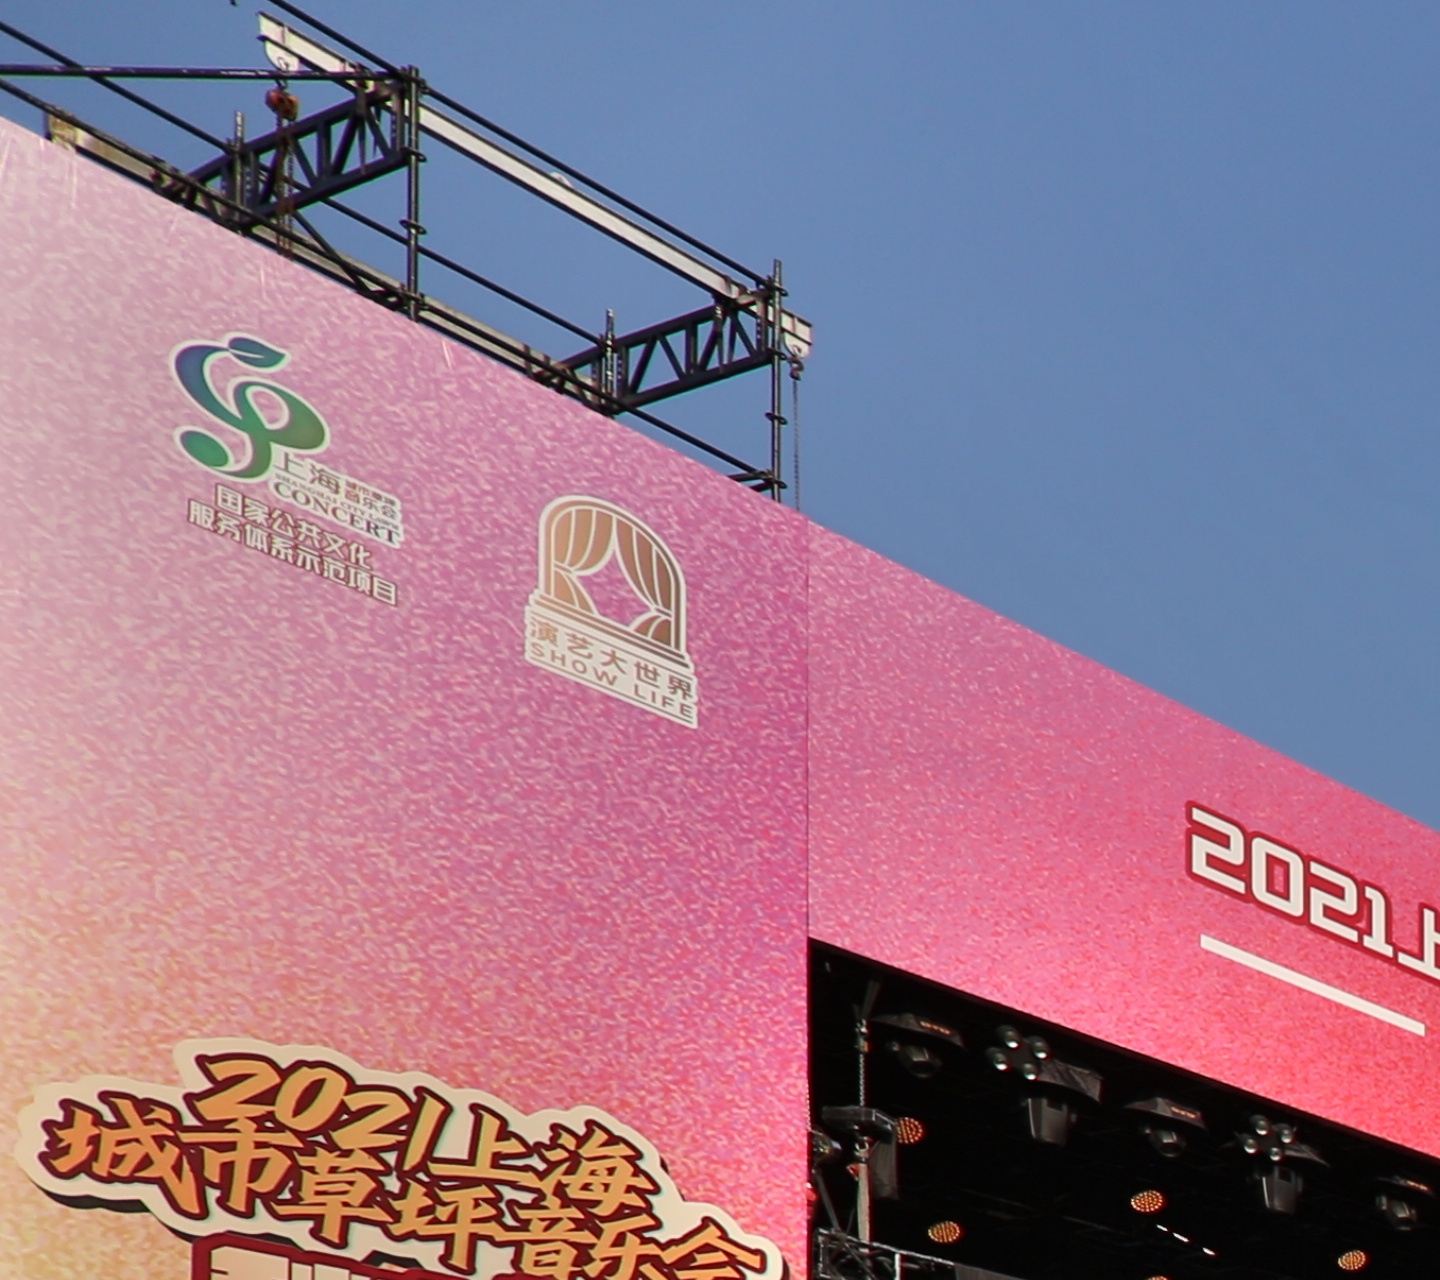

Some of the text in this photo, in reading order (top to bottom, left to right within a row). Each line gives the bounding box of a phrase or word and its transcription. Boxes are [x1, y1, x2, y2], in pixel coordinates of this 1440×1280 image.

[273, 451, 341, 496] 上海
[274, 482, 401, 546] CONCERT
[188, 498, 398, 608] 服务体系示范项目
[215, 483, 373, 571] 国家公共文化
[531, 615, 693, 701] 演艺大世界
[531, 642, 694, 720] SHOW LIFE
[197, 1056, 656, 1216] 2021上海
